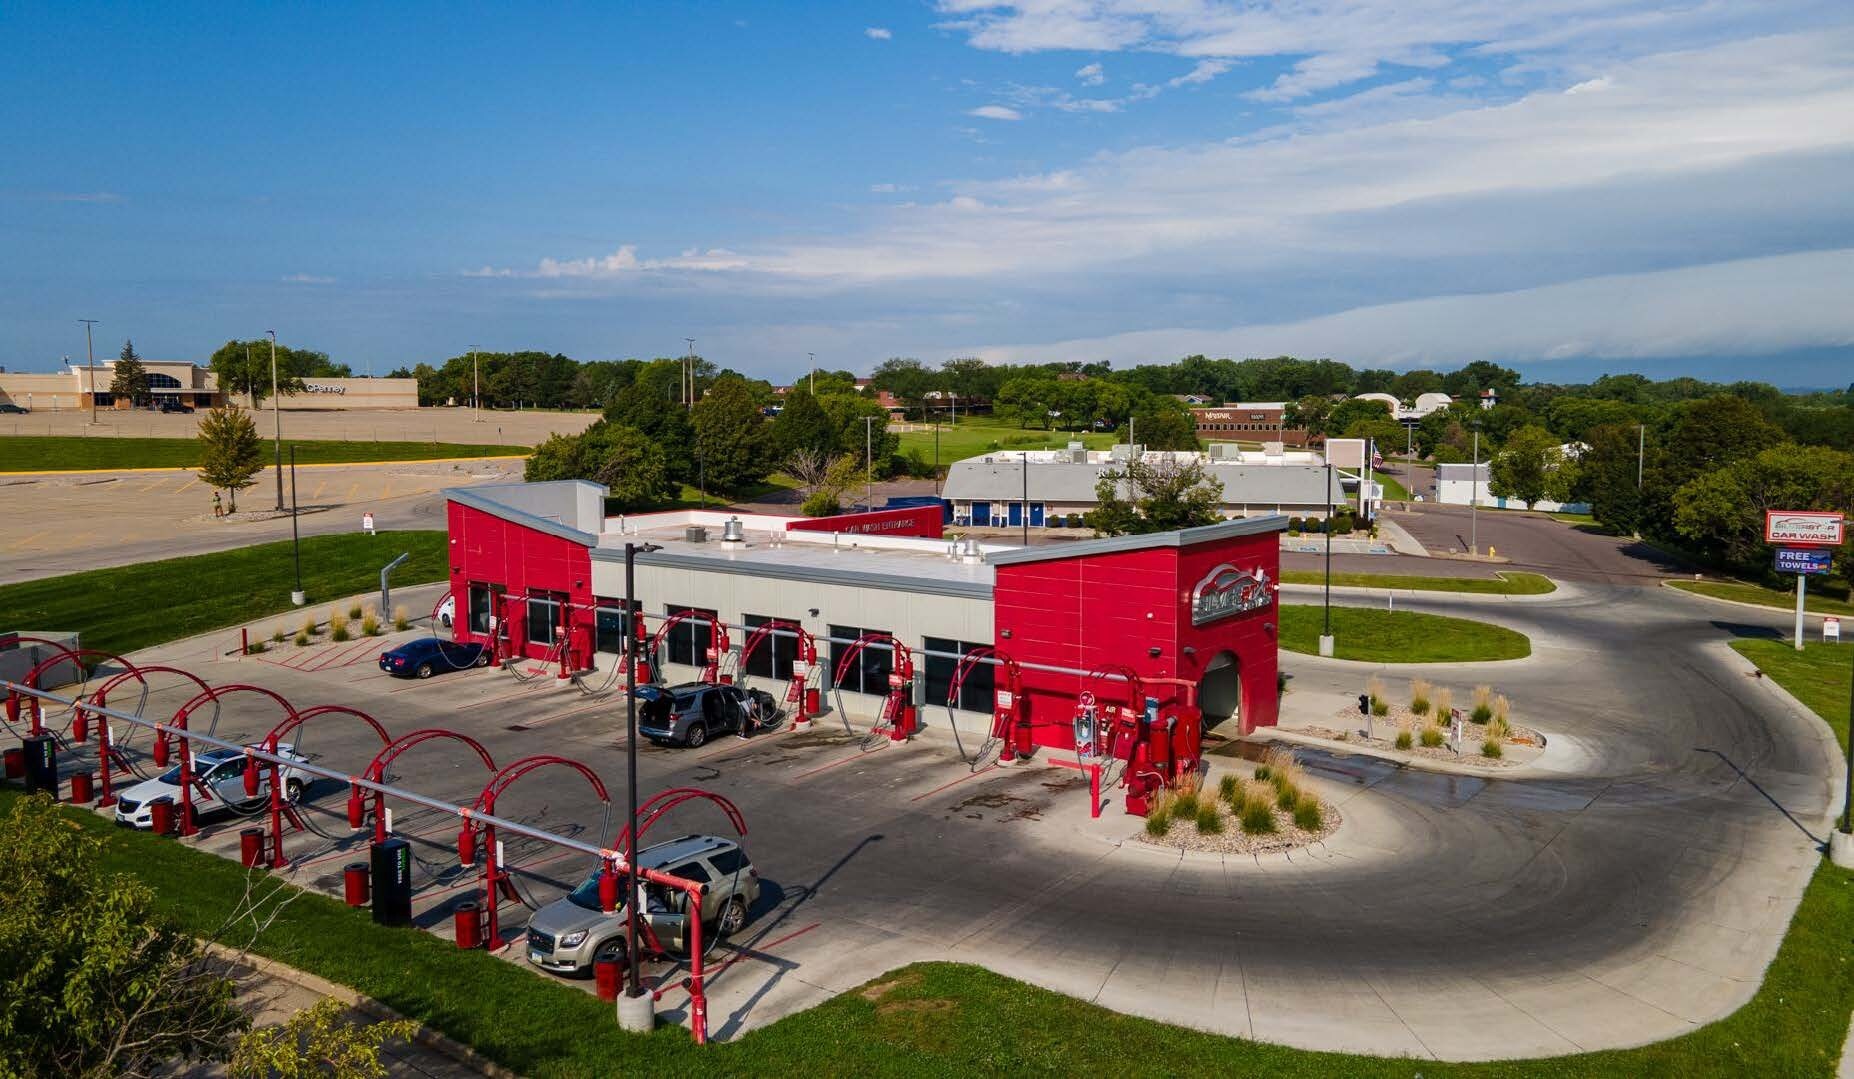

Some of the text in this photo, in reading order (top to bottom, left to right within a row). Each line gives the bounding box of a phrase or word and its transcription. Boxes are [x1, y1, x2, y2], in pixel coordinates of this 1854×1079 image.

[306, 383, 343, 394] CPenney
[1779, 551, 1810, 560] FREE
[1780, 561, 1818, 569] TOWELS
